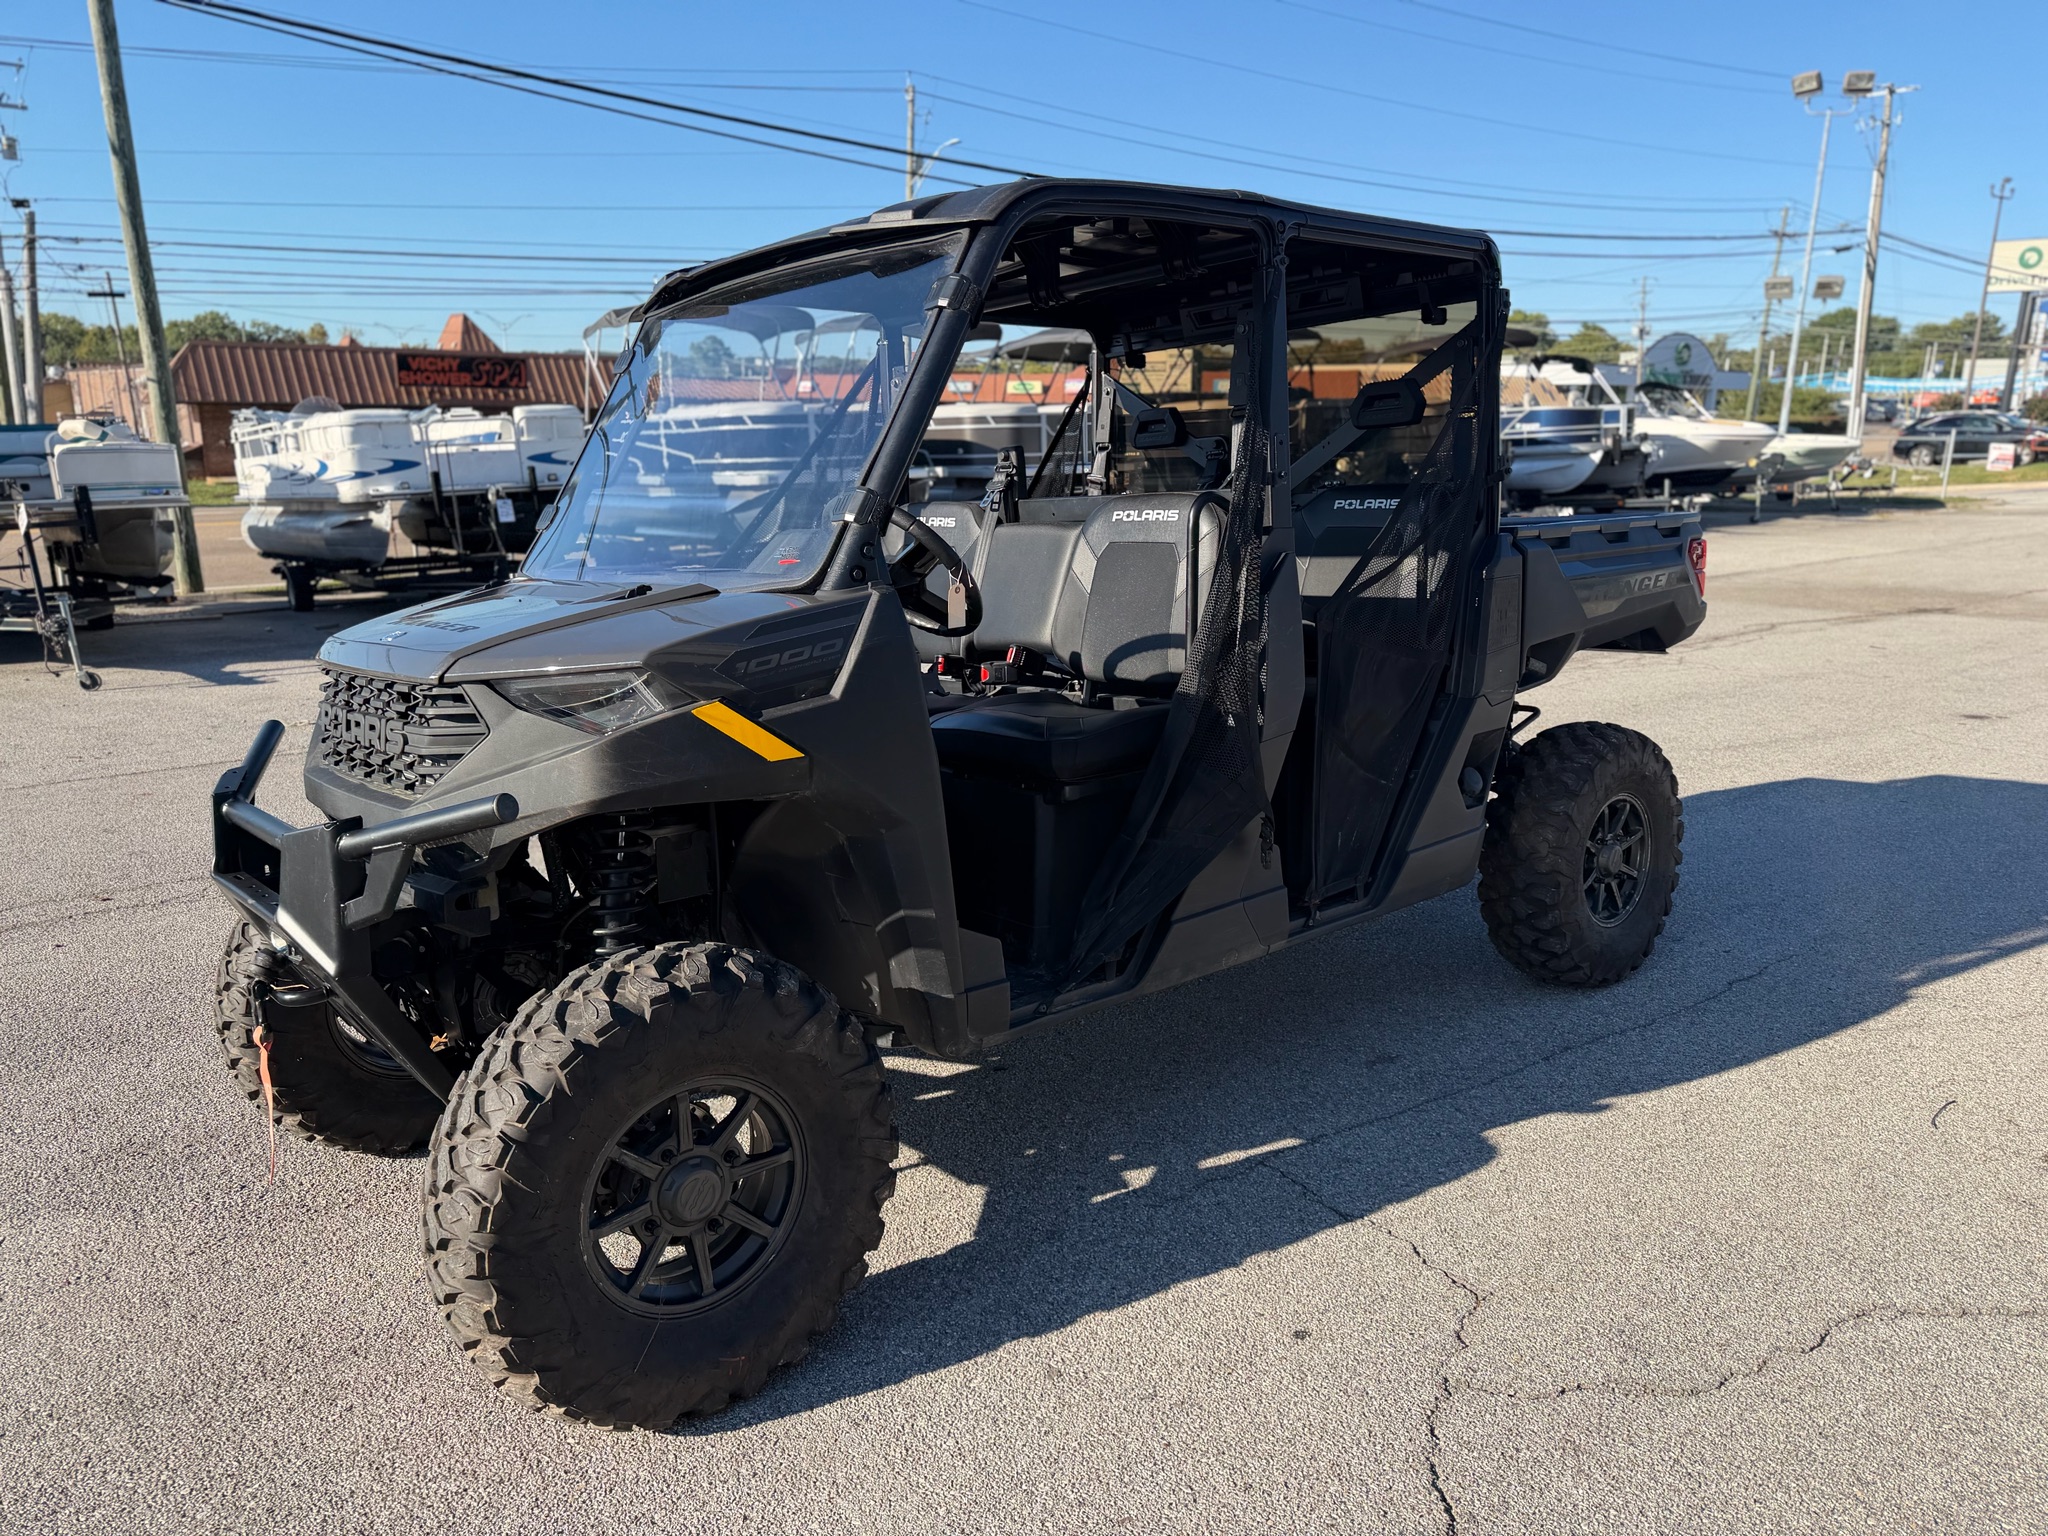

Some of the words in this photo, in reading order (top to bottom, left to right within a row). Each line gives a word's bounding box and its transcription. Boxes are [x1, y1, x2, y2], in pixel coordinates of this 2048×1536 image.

[407, 357, 460, 371] VICHY
[400, 371, 472, 385] SHOWER
[472, 359, 527, 387] SPA
[1334, 499, 1401, 510] POLARIS
[916, 516, 956, 527] LARIS
[1112, 510, 1180, 522] POLARIS
[735, 637, 844, 676] 1000
[319, 701, 405, 755] POLARIS
